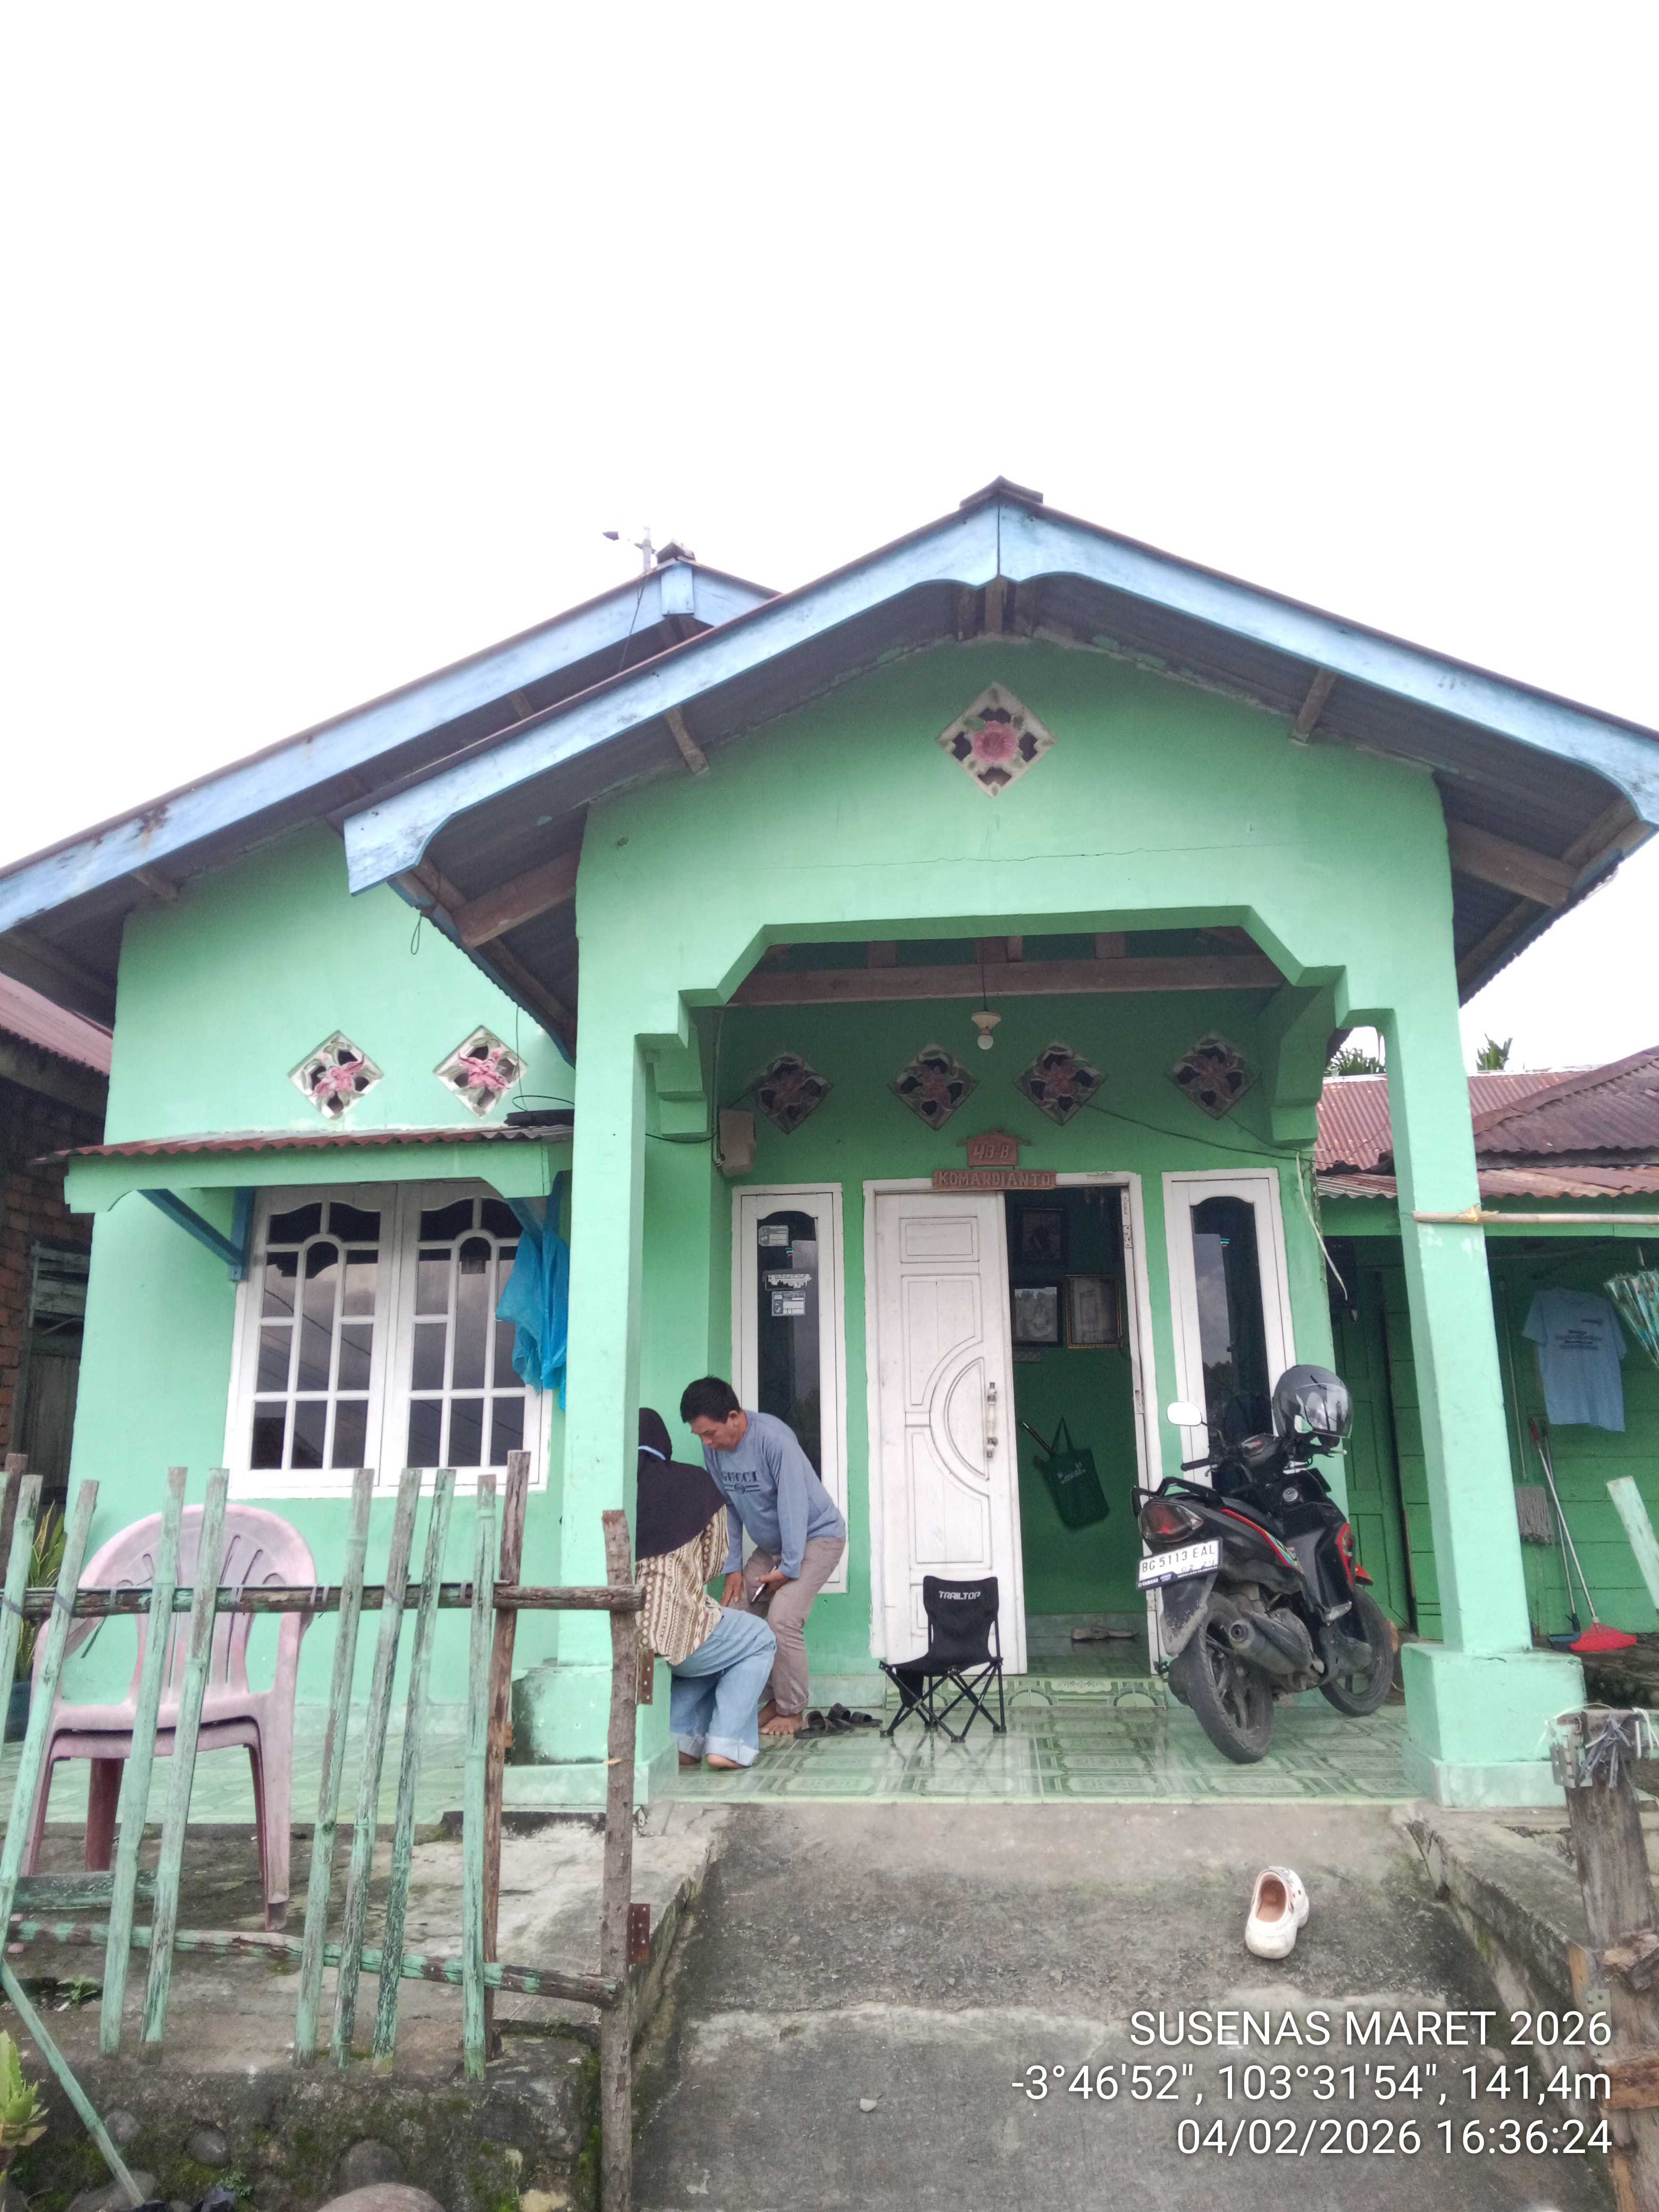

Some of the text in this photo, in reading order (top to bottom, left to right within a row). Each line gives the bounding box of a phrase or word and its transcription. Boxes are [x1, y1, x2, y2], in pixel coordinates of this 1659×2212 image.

[1142, 1545, 1216, 1573] BG 5113 EAL
[1142, 1577, 1159, 1587] YAMAHA
[939, 1590, 981, 1600] TRAILTOP
